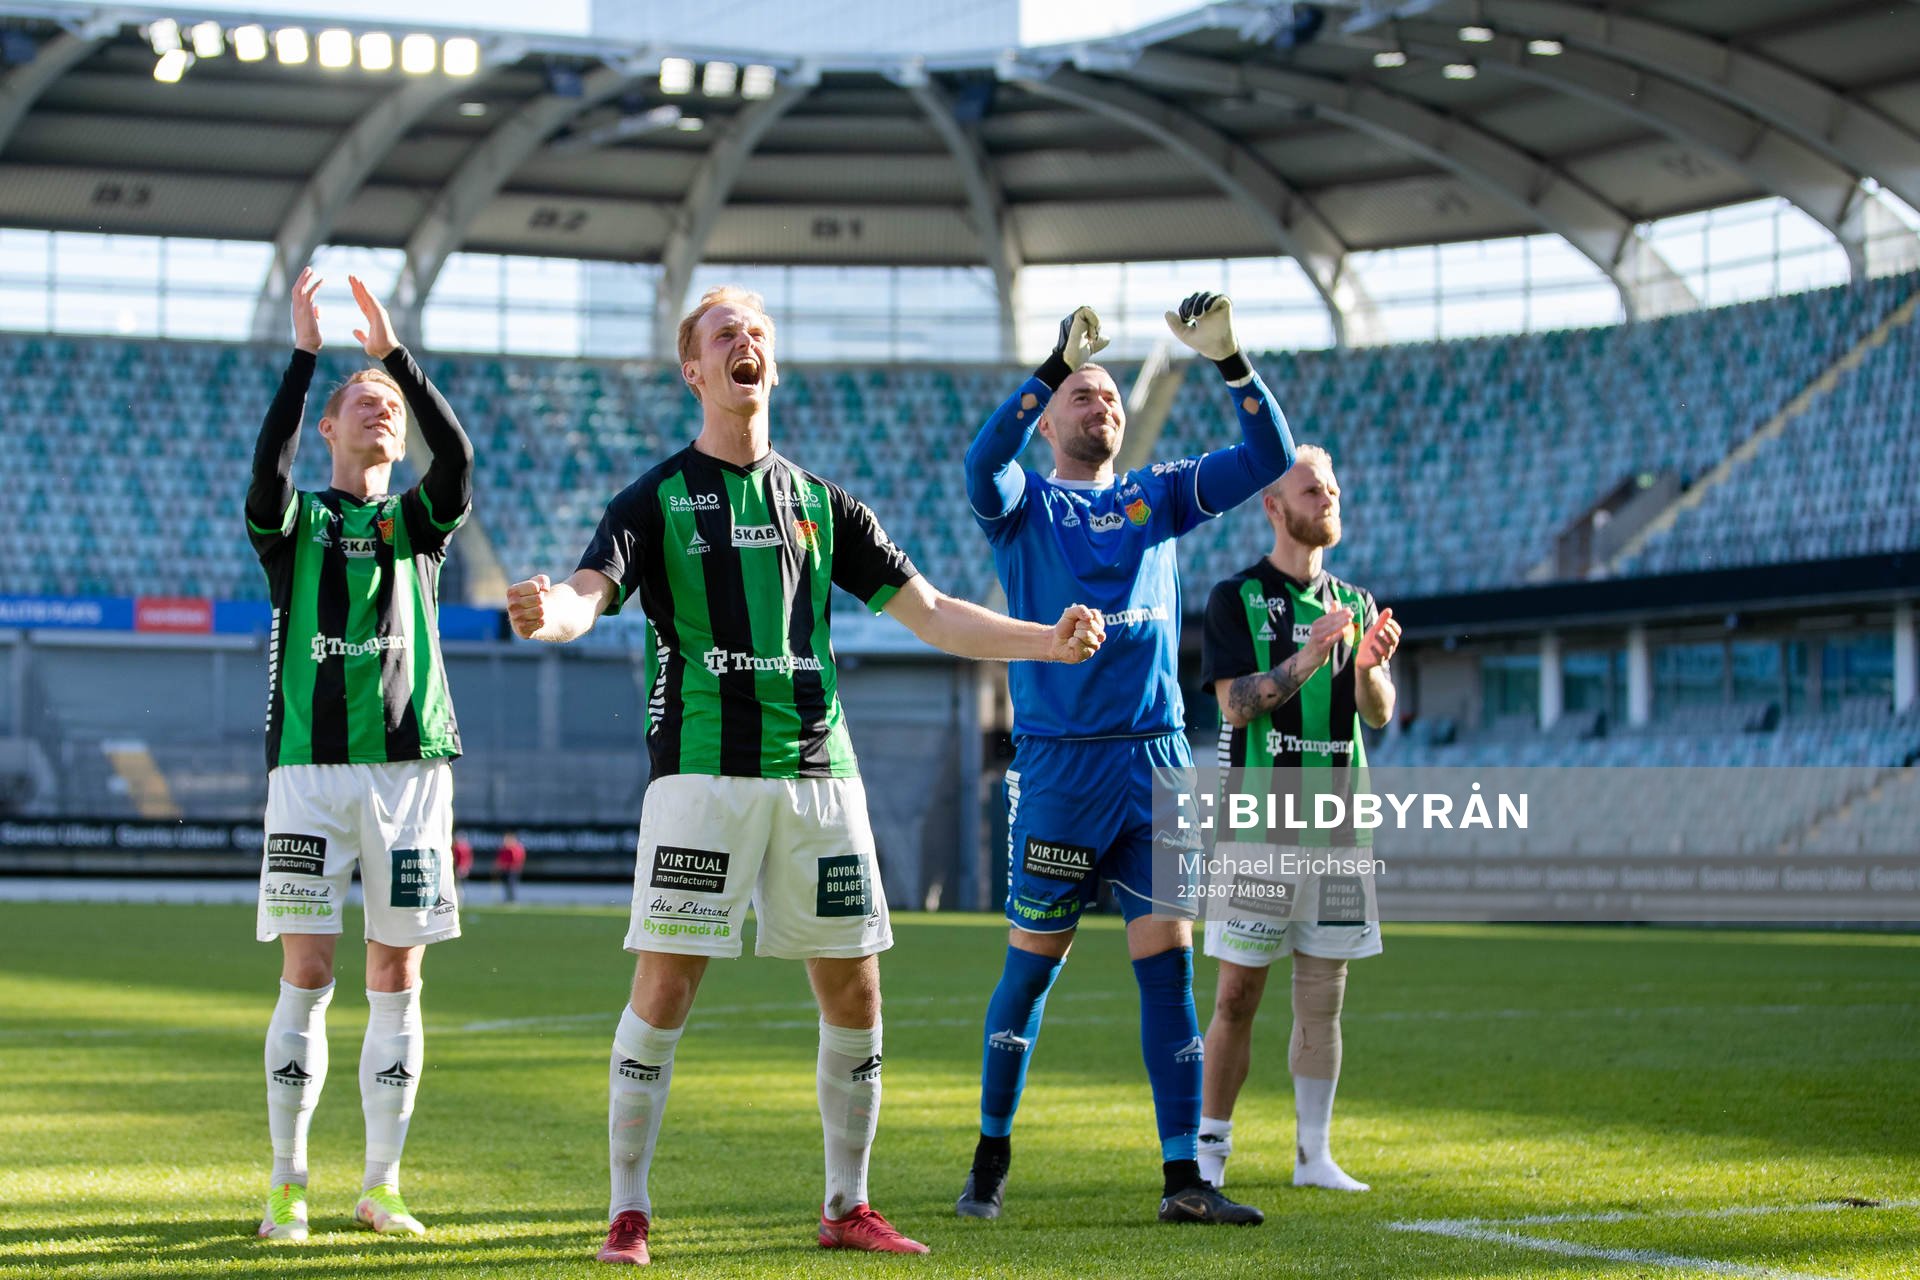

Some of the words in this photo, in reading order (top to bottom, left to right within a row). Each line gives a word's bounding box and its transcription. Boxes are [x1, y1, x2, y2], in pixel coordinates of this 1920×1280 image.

[669, 493, 719, 506] SALDO
[775, 490, 819, 503] SALDO
[735, 528, 776, 541] SKAB
[686, 545, 711, 556] SELECT
[269, 839, 321, 856] VIRTUAL
[1029, 842, 1090, 866] VIRTUAL
[659, 852, 722, 872] VIRTUAL
[826, 864, 865, 878] ADVOKAT
[1026, 862, 1086, 880] manufacturing
[655, 873, 718, 888] manufacturing
[826, 879, 865, 893] BOLAGET
[650, 895, 673, 912] Åke
[677, 901, 732, 917] Ekstrand
[844, 894, 866, 907] OPUS
[643, 918, 711, 936] Byggnads
[713, 925, 731, 937] AB
[618, 1067, 661, 1081] SELECT
[376, 1077, 409, 1087] SELEC
